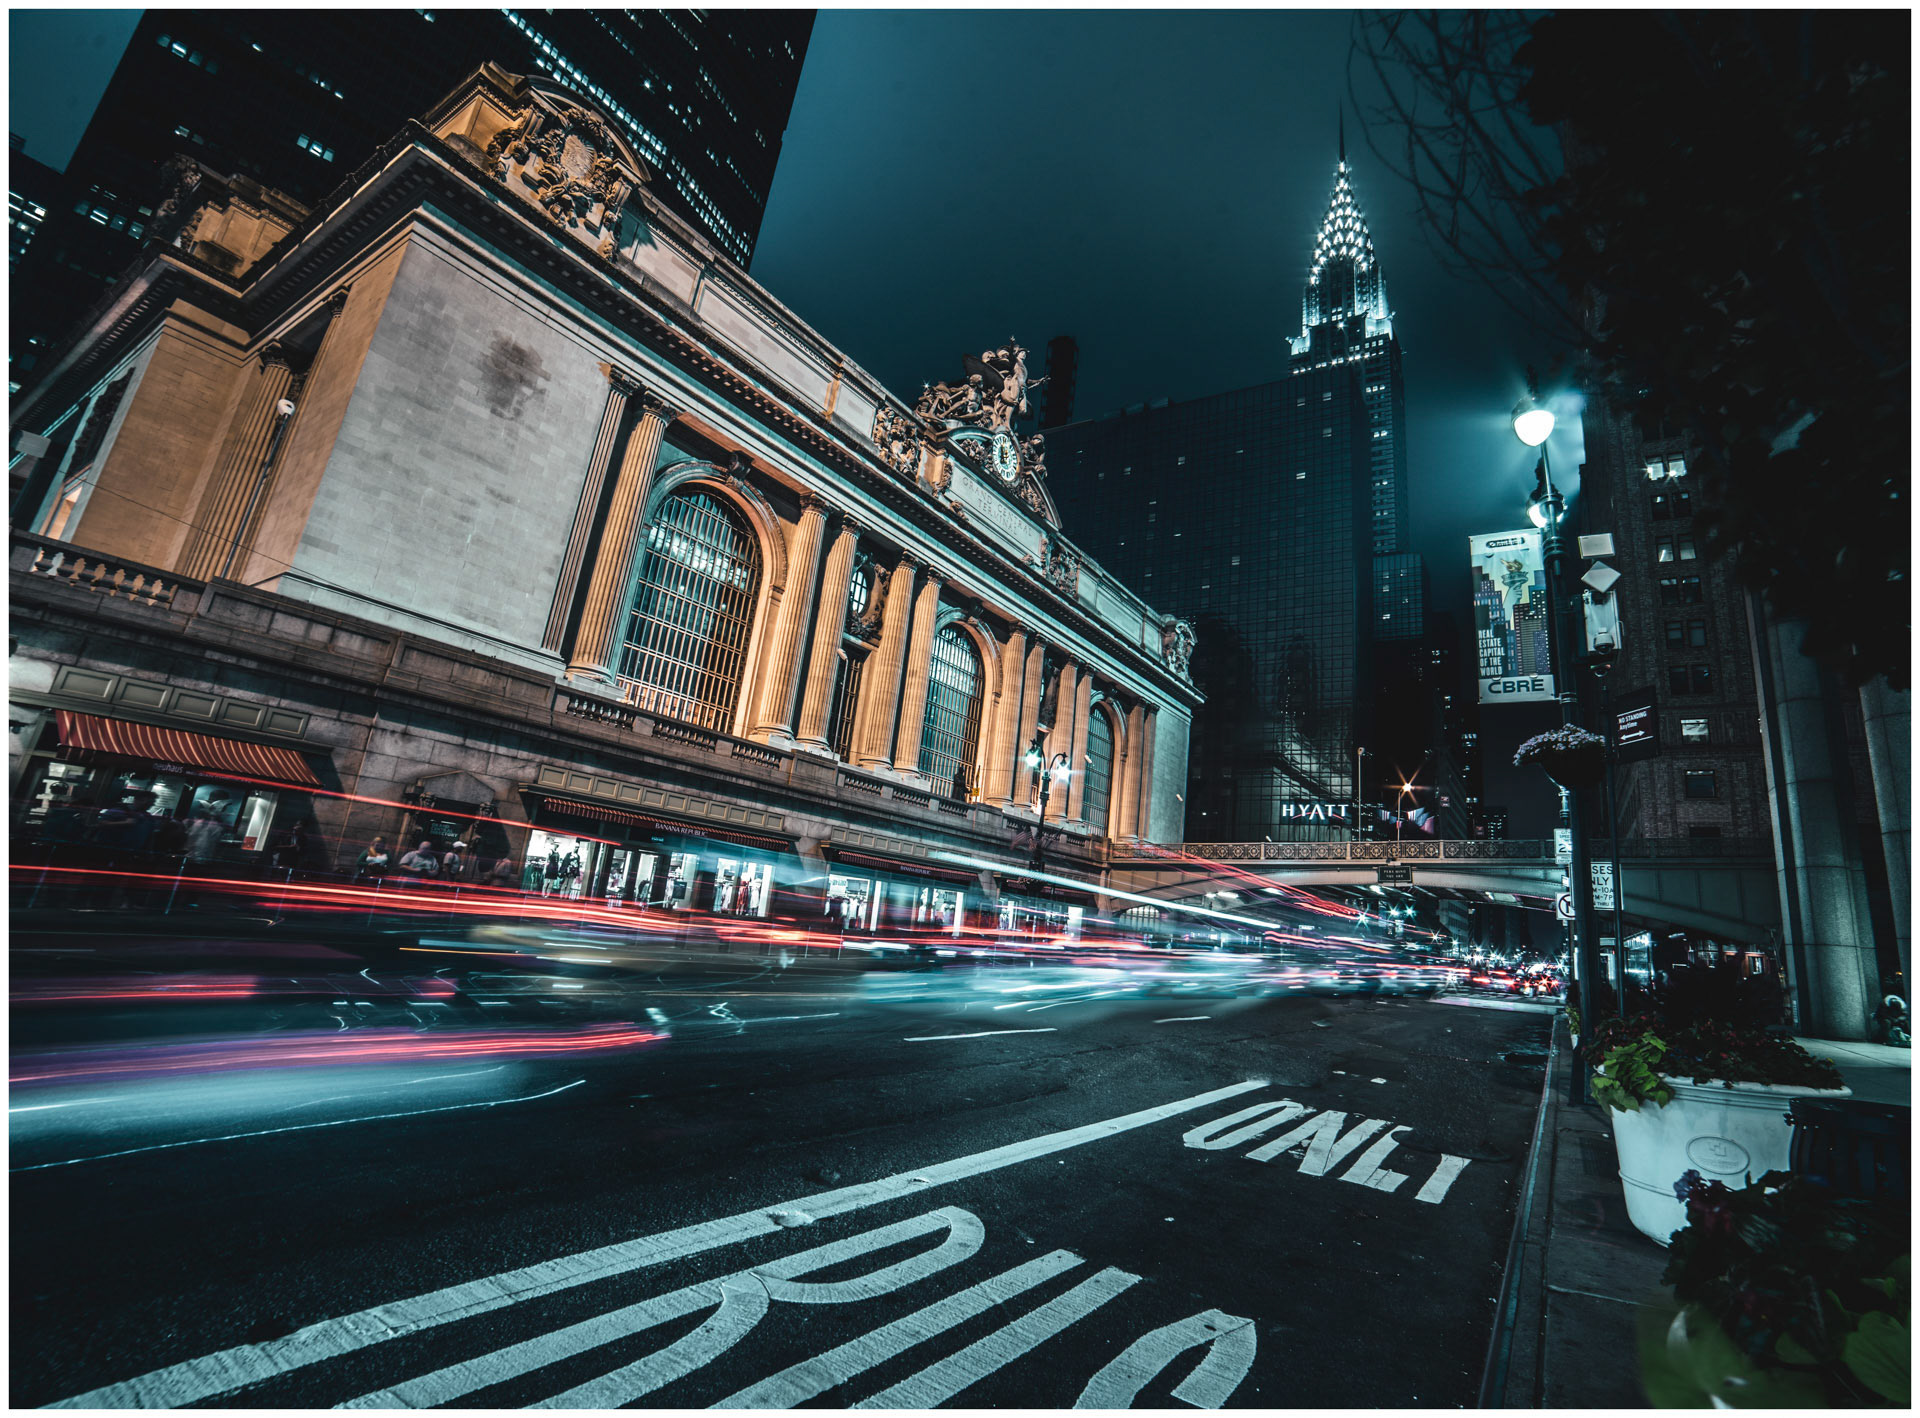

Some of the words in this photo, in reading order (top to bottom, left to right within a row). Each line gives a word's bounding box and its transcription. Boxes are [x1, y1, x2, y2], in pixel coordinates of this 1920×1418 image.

[962, 477, 992, 505] GRAND
[997, 504, 1032, 537] CENTRAL
[978, 498, 1017, 536] TERMINAL
[1478, 629, 1494, 639] REAL
[1478, 637, 1502, 648] ESTATE
[1479, 646, 1506, 658] CAPITAL
[1480, 658, 1488, 667] OF
[1489, 656, 1502, 666] THE
[1480, 666, 1503, 677] WORLD
[1487, 679, 1544, 694] CBRE
[1282, 803, 1349, 820] HYATT
[655, 823, 681, 833] BANANA
[681, 828, 708, 837] REPUBLIC
[1592, 865, 1614, 875] SES
[1591, 876, 1610, 886] NLY
